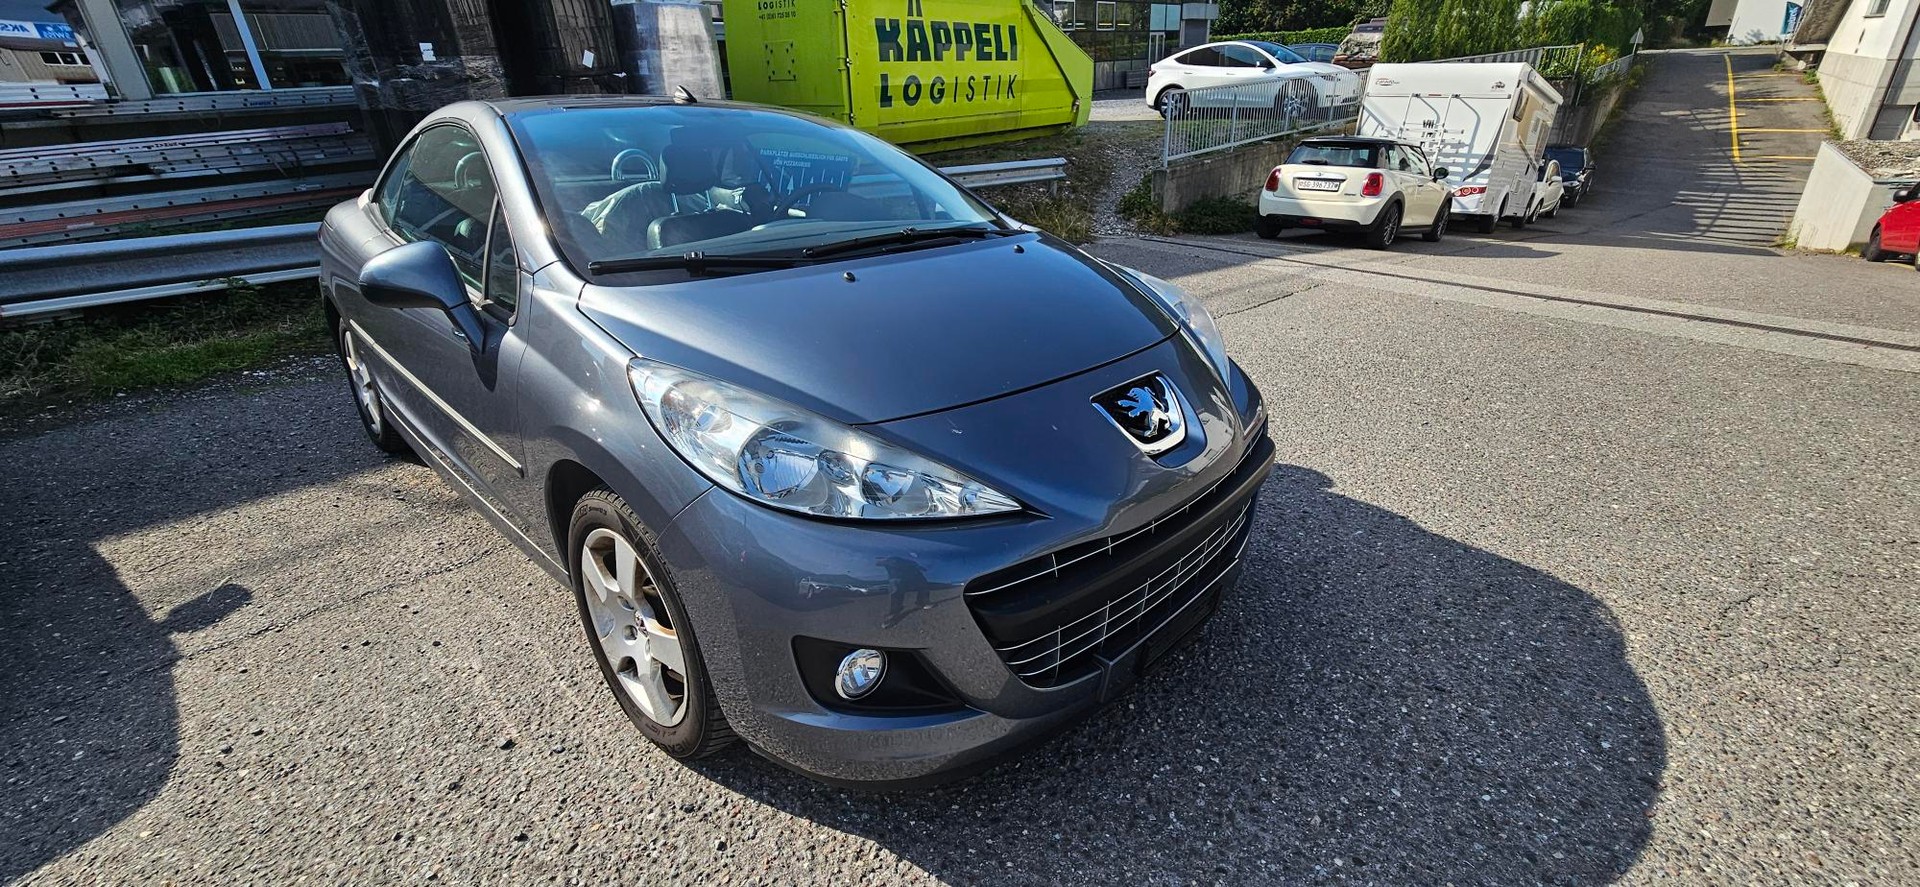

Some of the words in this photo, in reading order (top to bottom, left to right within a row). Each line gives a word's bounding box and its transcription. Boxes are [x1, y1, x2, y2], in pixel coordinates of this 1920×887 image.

[758, 0, 796, 10] LOGISTIK
[875, 0, 1018, 62] KÄPPELI
[880, 73, 1017, 108] LOGISTIK
